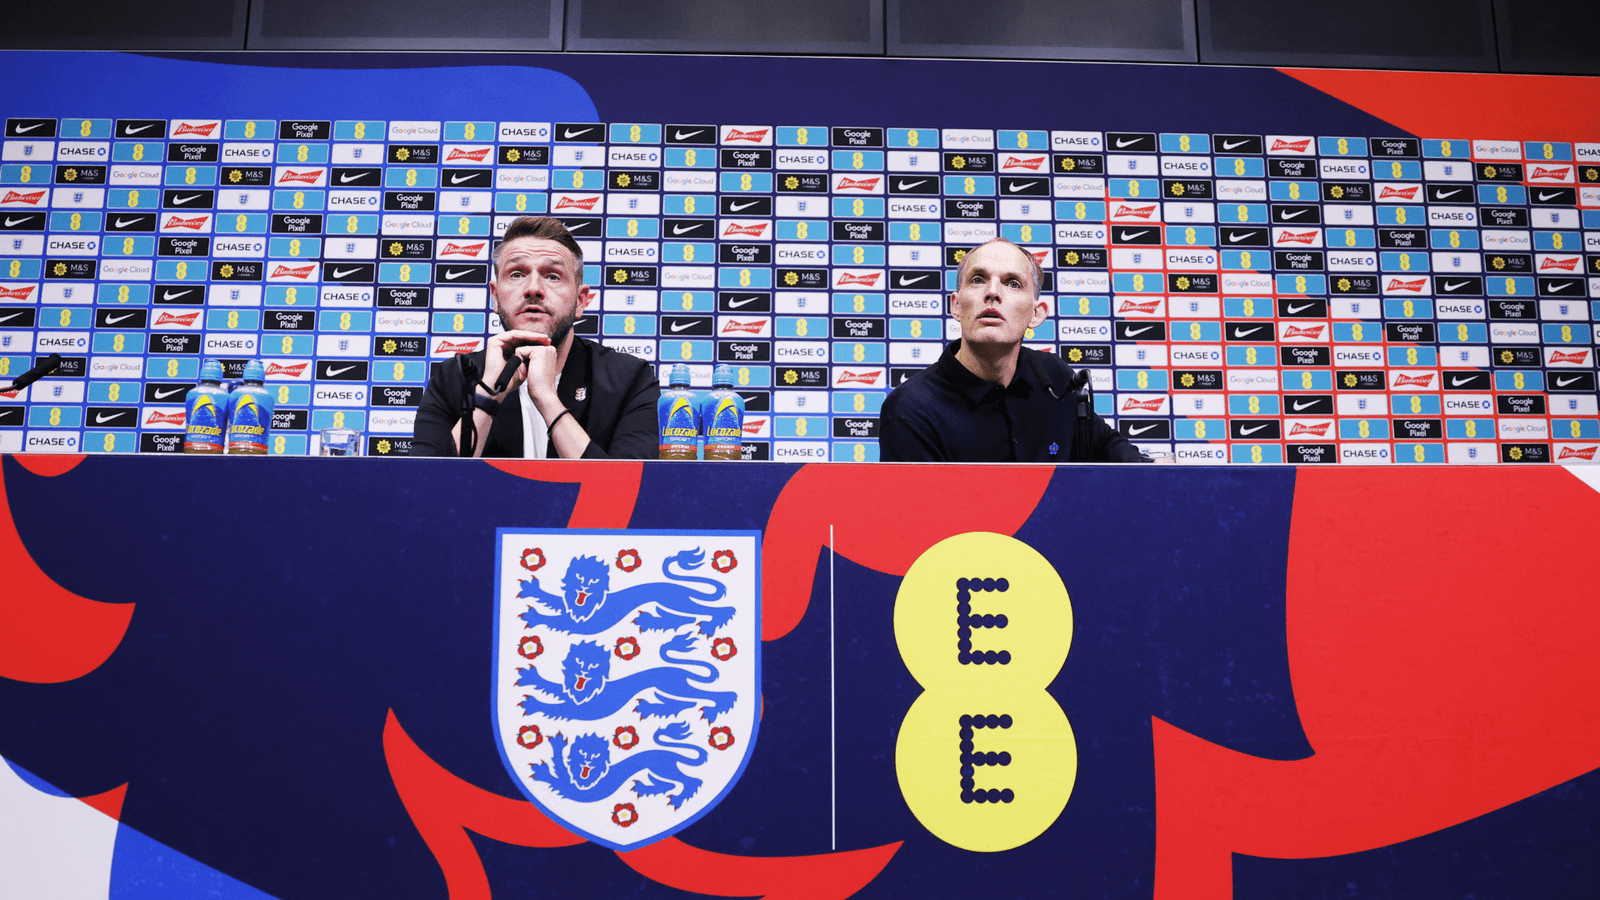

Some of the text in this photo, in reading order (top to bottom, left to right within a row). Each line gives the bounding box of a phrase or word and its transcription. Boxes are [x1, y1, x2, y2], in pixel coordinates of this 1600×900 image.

[178, 124, 214, 134] Budweiser
[292, 123, 318, 131] Google
[391, 126, 417, 135] Google
[296, 130, 313, 138] Pixel
[502, 128, 536, 136] CHASE
[729, 131, 765, 140] Budweiser
[844, 130, 871, 138] Google
[849, 137, 867, 145] Pixel
[945, 135, 970, 143] Google
[1054, 137, 1089, 145] CHASE
[1274, 140, 1307, 150] Budweiser
[1381, 140, 1407, 149] Google
[180, 145, 207, 154] Google
[1387, 147, 1404, 155] Pixel
[1476, 145, 1499, 154] Google
[184, 152, 201, 160] Pixel
[450, 150, 486, 159] Budweiser
[611, 153, 646, 161] CHASE
[733, 151, 760, 160] Google
[738, 158, 755, 166] Pixel
[1007, 158, 1041, 168] Budweiser
[1164, 162, 1198, 170] CHASE
[112, 170, 138, 180] Google
[283, 172, 319, 181] Budweiser
[840, 179, 876, 188] Budweiser
[1056, 183, 1081, 191] Google
[1383, 188, 1415, 197] Budweiser
[396, 193, 423, 203] Google
[401, 201, 418, 209] Pixel
[559, 198, 595, 208] Budweiser
[956, 201, 983, 210] Google
[891, 204, 926, 212] CHASE
[1118, 207, 1152, 216] Budweiser
[962, 209, 979, 217] Pixel
[168, 218, 204, 227] Budweiser
[283, 216, 310, 225] Google
[385, 220, 410, 229] Google
[288, 223, 305, 232] Pixel
[845, 223, 872, 233] Google
[850, 231, 868, 239] Pixel
[1059, 230, 1093, 238] CHASE
[171, 239, 197, 248] Google
[1485, 235, 1508, 244] Google
[50, 241, 85, 249] CHASE
[216, 243, 251, 251] CHASE
[406, 243, 424, 251] M&S
[445, 244, 481, 254] Budweiser
[175, 246, 192, 254] Pixel
[608, 248, 644, 256] CHASE
[731, 246, 759, 255] Google
[778, 250, 814, 258] CHASE
[736, 253, 754, 261] Pixel
[1286, 253, 1312, 262] Google
[1330, 257, 1363, 265] CHASE
[1291, 260, 1308, 268] Pixel
[103, 265, 128, 274] Google
[275, 267, 311, 276] Budweiser
[1390, 280, 1423, 290] Budweiser
[390, 289, 417, 299] Google
[394, 297, 412, 305] Pixel
[892, 300, 927, 308] CHASE
[276, 312, 303, 322] Google
[280, 320, 298, 328] Pixel
[726, 321, 762, 331] Budweiser
[845, 320, 873, 329] Google
[850, 328, 868, 336] Pixel
[1287, 327, 1321, 336] Budweiser
[1397, 325, 1423, 334] Google
[161, 335, 189, 345] Google
[1402, 332, 1419, 340] Pixel
[39, 338, 75, 346] CHASE
[207, 340, 243, 348] CHASE
[166, 343, 183, 352] Pixel
[730, 343, 758, 353] Google
[778, 348, 813, 356] CHASE
[735, 351, 753, 359] Pixel
[1085, 349, 1104, 357] M&S
[1174, 352, 1208, 360] CHASE
[1292, 348, 1318, 357] Google
[1337, 352, 1370, 360] CHASE
[1297, 356, 1314, 364] Pixel
[93, 363, 119, 372] Google
[801, 371, 820, 379] M&S
[841, 372, 877, 382] Budweiser
[1398, 375, 1431, 385] Budweiser
[316, 391, 352, 399] CHASE
[384, 388, 411, 398] Google
[388, 396, 406, 405] Pixel
[1126, 399, 1161, 409] Budweiser
[845, 419, 873, 429] Google
[1404, 421, 1430, 430] Google
[1501, 424, 1525, 433] Google
[850, 427, 868, 436] Pixel
[1293, 424, 1327, 434] Budweiser
[1410, 428, 1426, 437] Pixel
[29, 437, 65, 446] CHASE
[153, 435, 180, 444] Google
[157, 443, 175, 451] Pixel
[1298, 446, 1324, 455] Google
[777, 448, 813, 456] CHASE
[1178, 450, 1213, 458] CHASE
[1343, 450, 1377, 458] CHASE
[1303, 454, 1320, 462] Pixel
